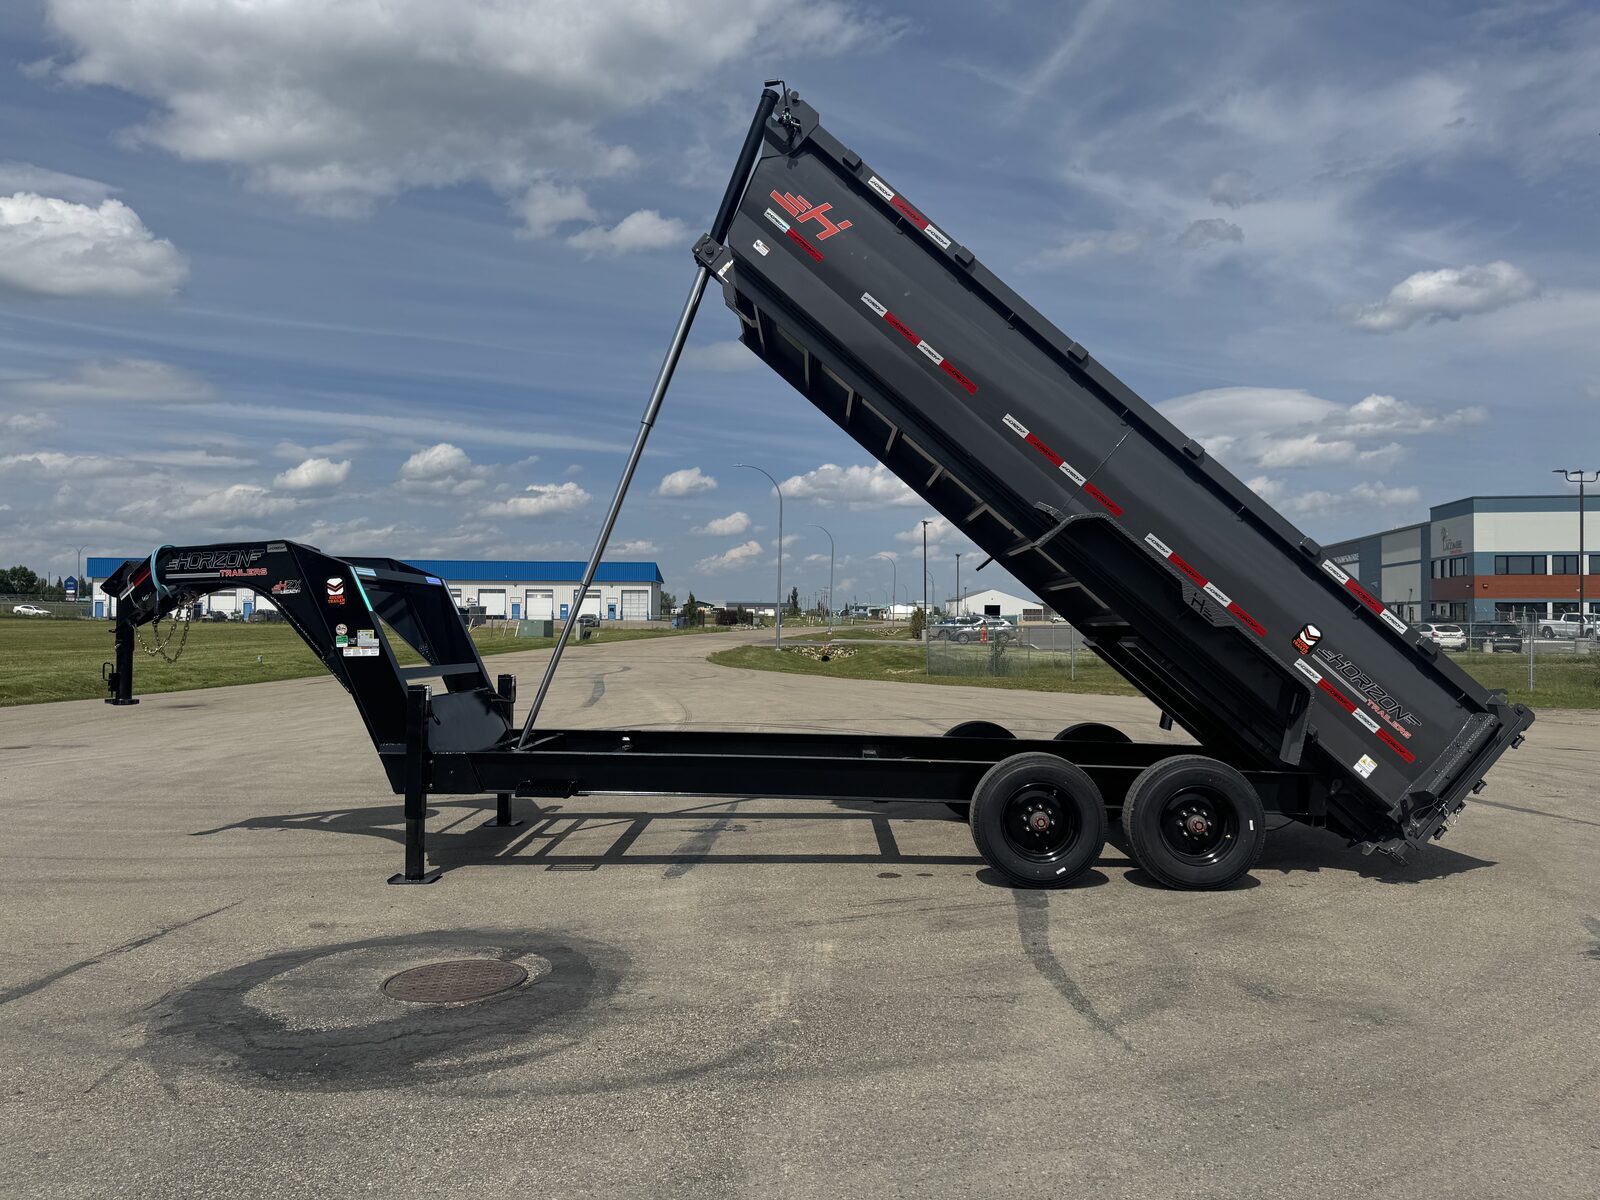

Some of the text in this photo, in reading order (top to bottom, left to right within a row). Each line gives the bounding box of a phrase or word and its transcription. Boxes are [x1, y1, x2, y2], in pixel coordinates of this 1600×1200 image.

[171, 549, 259, 570] HORIZON
[220, 567, 268, 577] TRAILERS
[1324, 652, 1415, 723] HORIZON
[1367, 699, 1412, 739] TRAILERS
